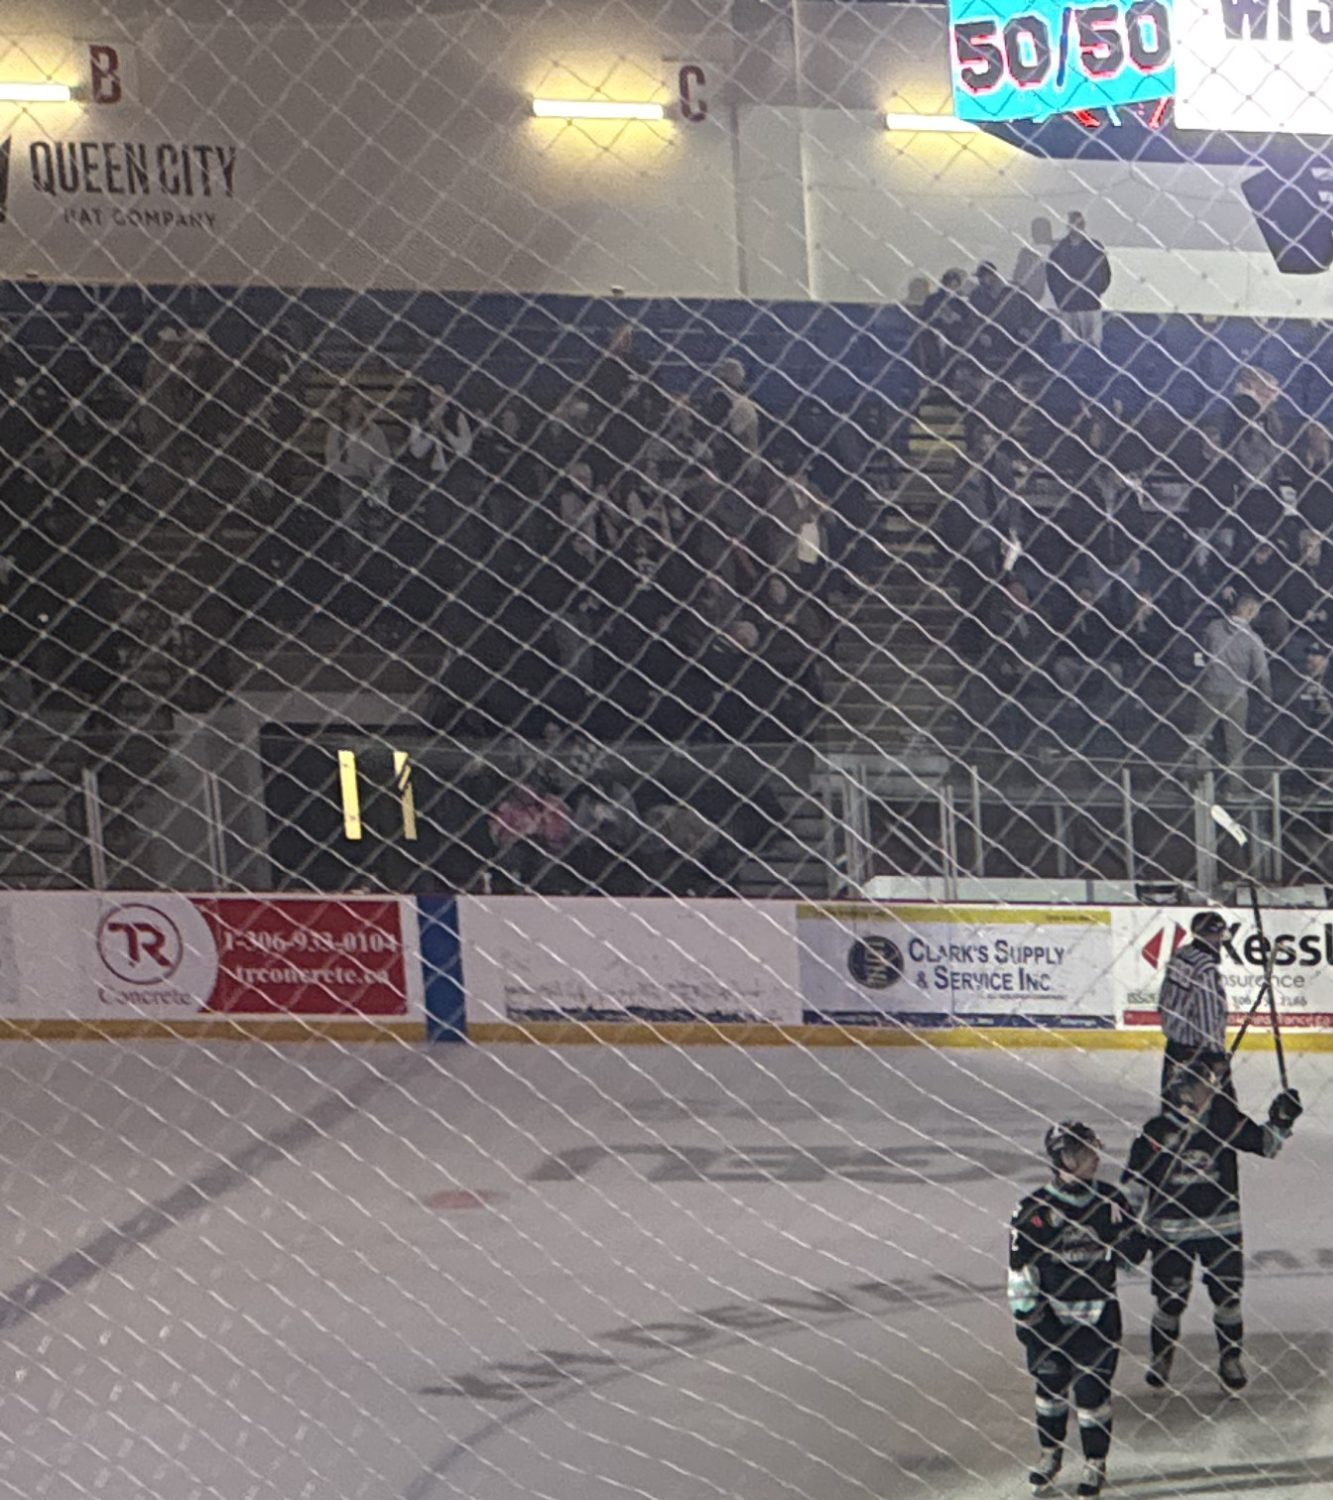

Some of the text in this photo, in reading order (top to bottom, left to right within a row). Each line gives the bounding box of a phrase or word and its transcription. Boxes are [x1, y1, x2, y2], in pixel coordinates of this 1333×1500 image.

[89, 44, 122, 104] B
[954, 1, 1171, 91] 50/50
[678, 65, 707, 123] C
[29, 141, 237, 197] QUEEN CITY
[112, 208, 217, 228] COMPANY
[1220, 973, 1305, 989] nsurance
